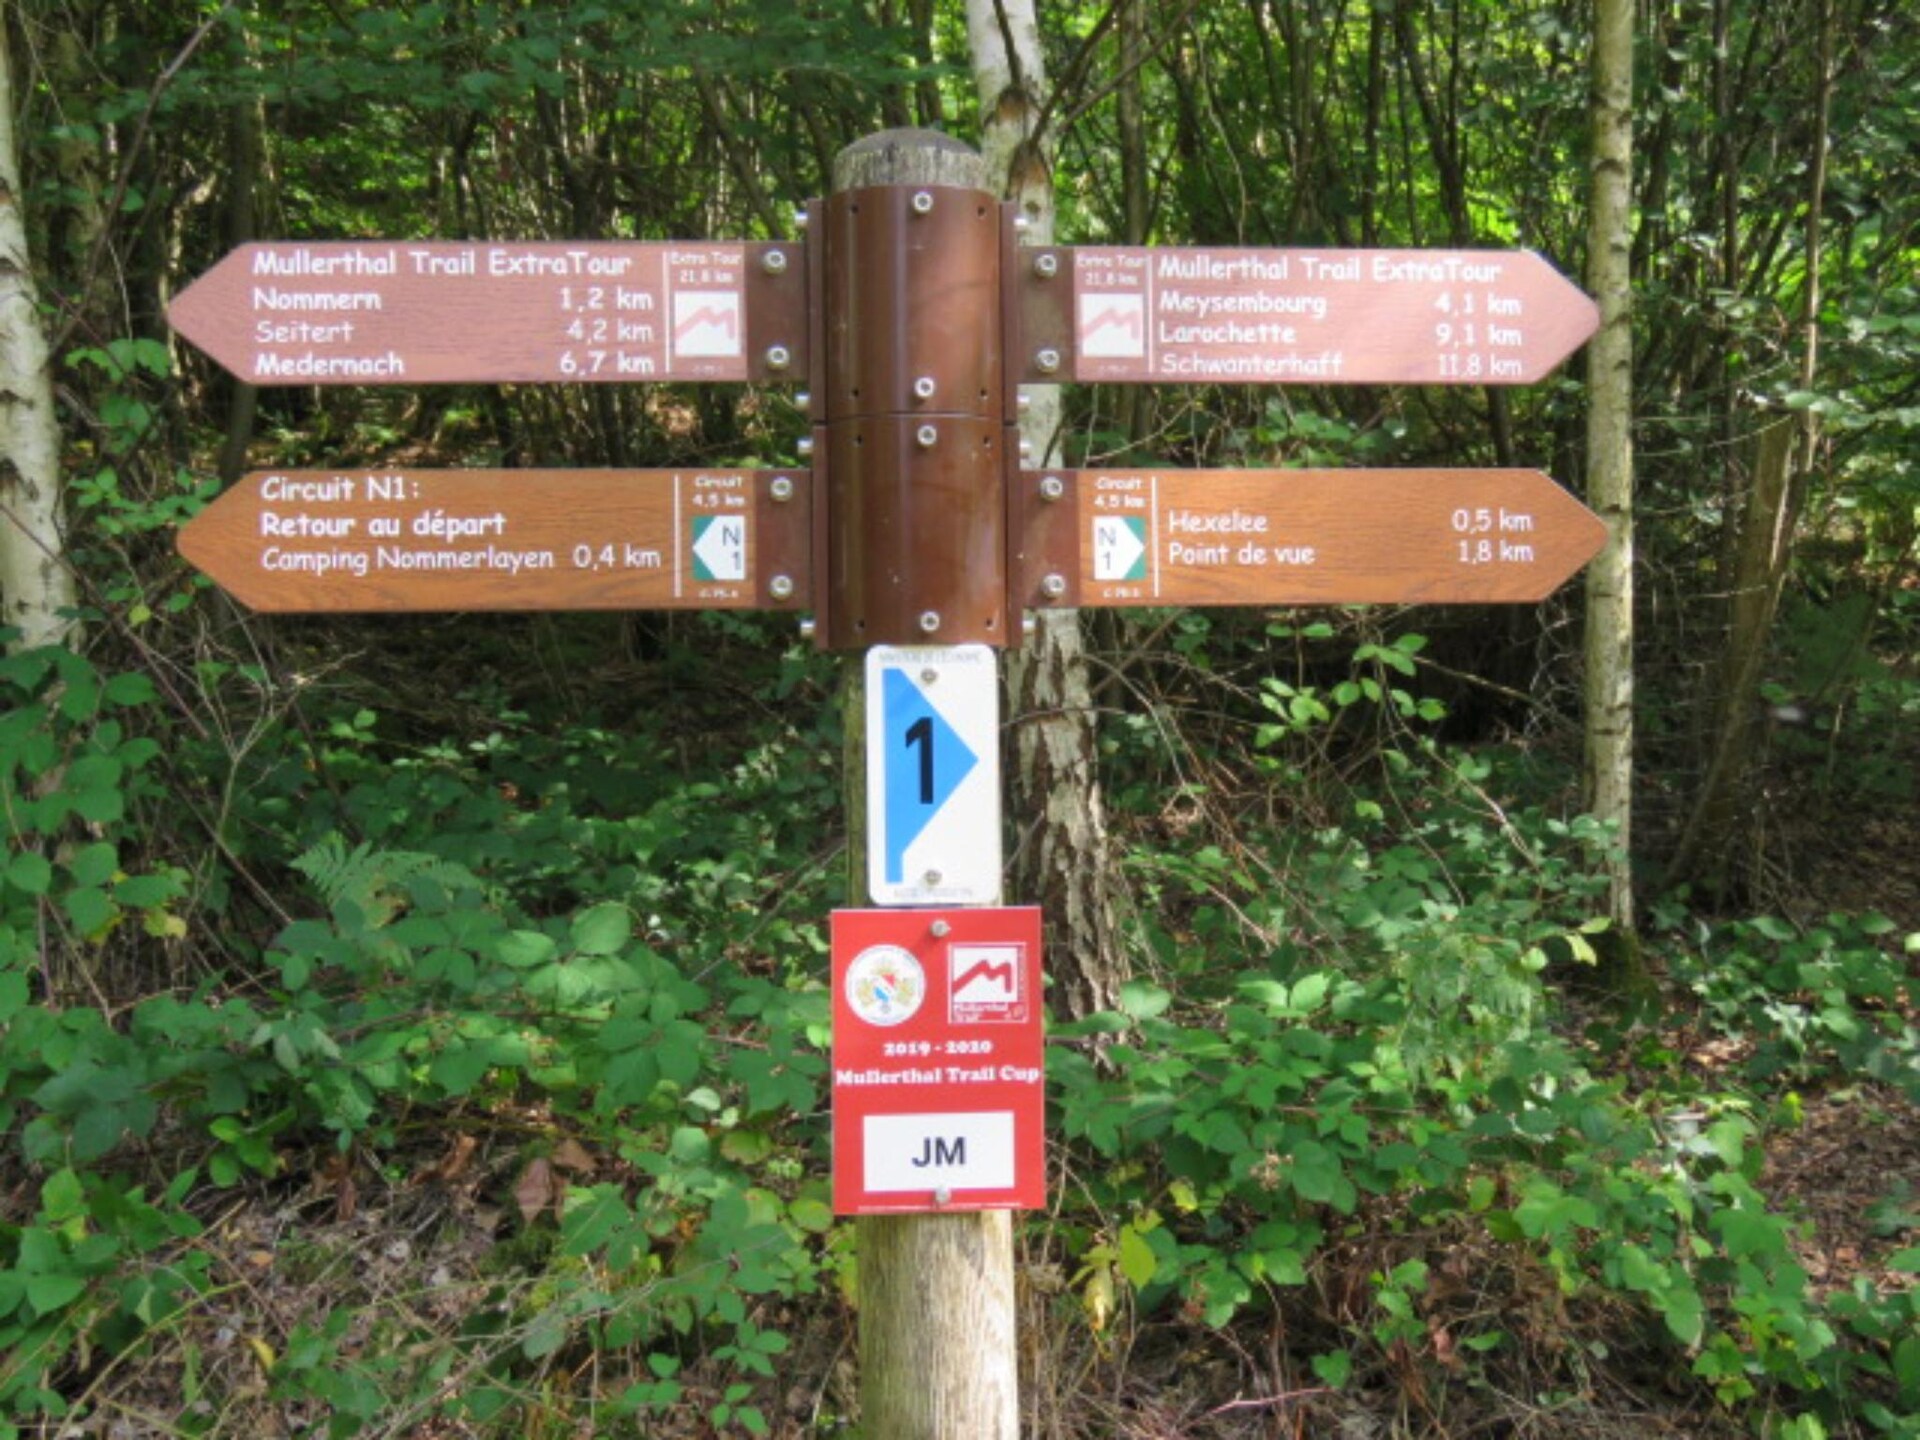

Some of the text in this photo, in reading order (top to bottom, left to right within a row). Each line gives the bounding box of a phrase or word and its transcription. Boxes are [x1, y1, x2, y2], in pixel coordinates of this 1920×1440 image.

[253, 250, 632, 276] Mullerthal Trail ExtraTour
[1158, 255, 1502, 282] Mullerthal Trail ExtraTour
[253, 286, 653, 312] Nommern 1,2 km
[1159, 290, 1522, 319] Meysembourg 4,1 km
[255, 319, 654, 345] Seitert 4,2 km
[1159, 321, 1522, 348] Larochette 9,1 km
[255, 351, 655, 376] Medernach 6,7 km
[1162, 352, 1522, 377] Schwanterhaff 11,8 km
[261, 476, 420, 501] Circuit N1:
[695, 475, 743, 488] Circuit
[725, 493, 745, 507] km
[1124, 494, 1145, 507] km
[261, 509, 506, 543] Retour au départ
[1168, 507, 1534, 534] Hexelee 0,5 km
[722, 525, 741, 547] N
[1098, 526, 1116, 547] N
[261, 543, 662, 576] Camping Nommerlayen 0,4 km
[732, 552, 741, 571] 1
[1103, 552, 1111, 571] 1
[1168, 540, 1534, 565] Point de vue 1,8 km
[905, 716, 934, 805] 1
[883, 1040, 931, 1056] 2019
[945, 1040, 993, 1055] 2020
[836, 1065, 1041, 1086] Mullerthal Trail Cup
[911, 1135, 966, 1168] JM
